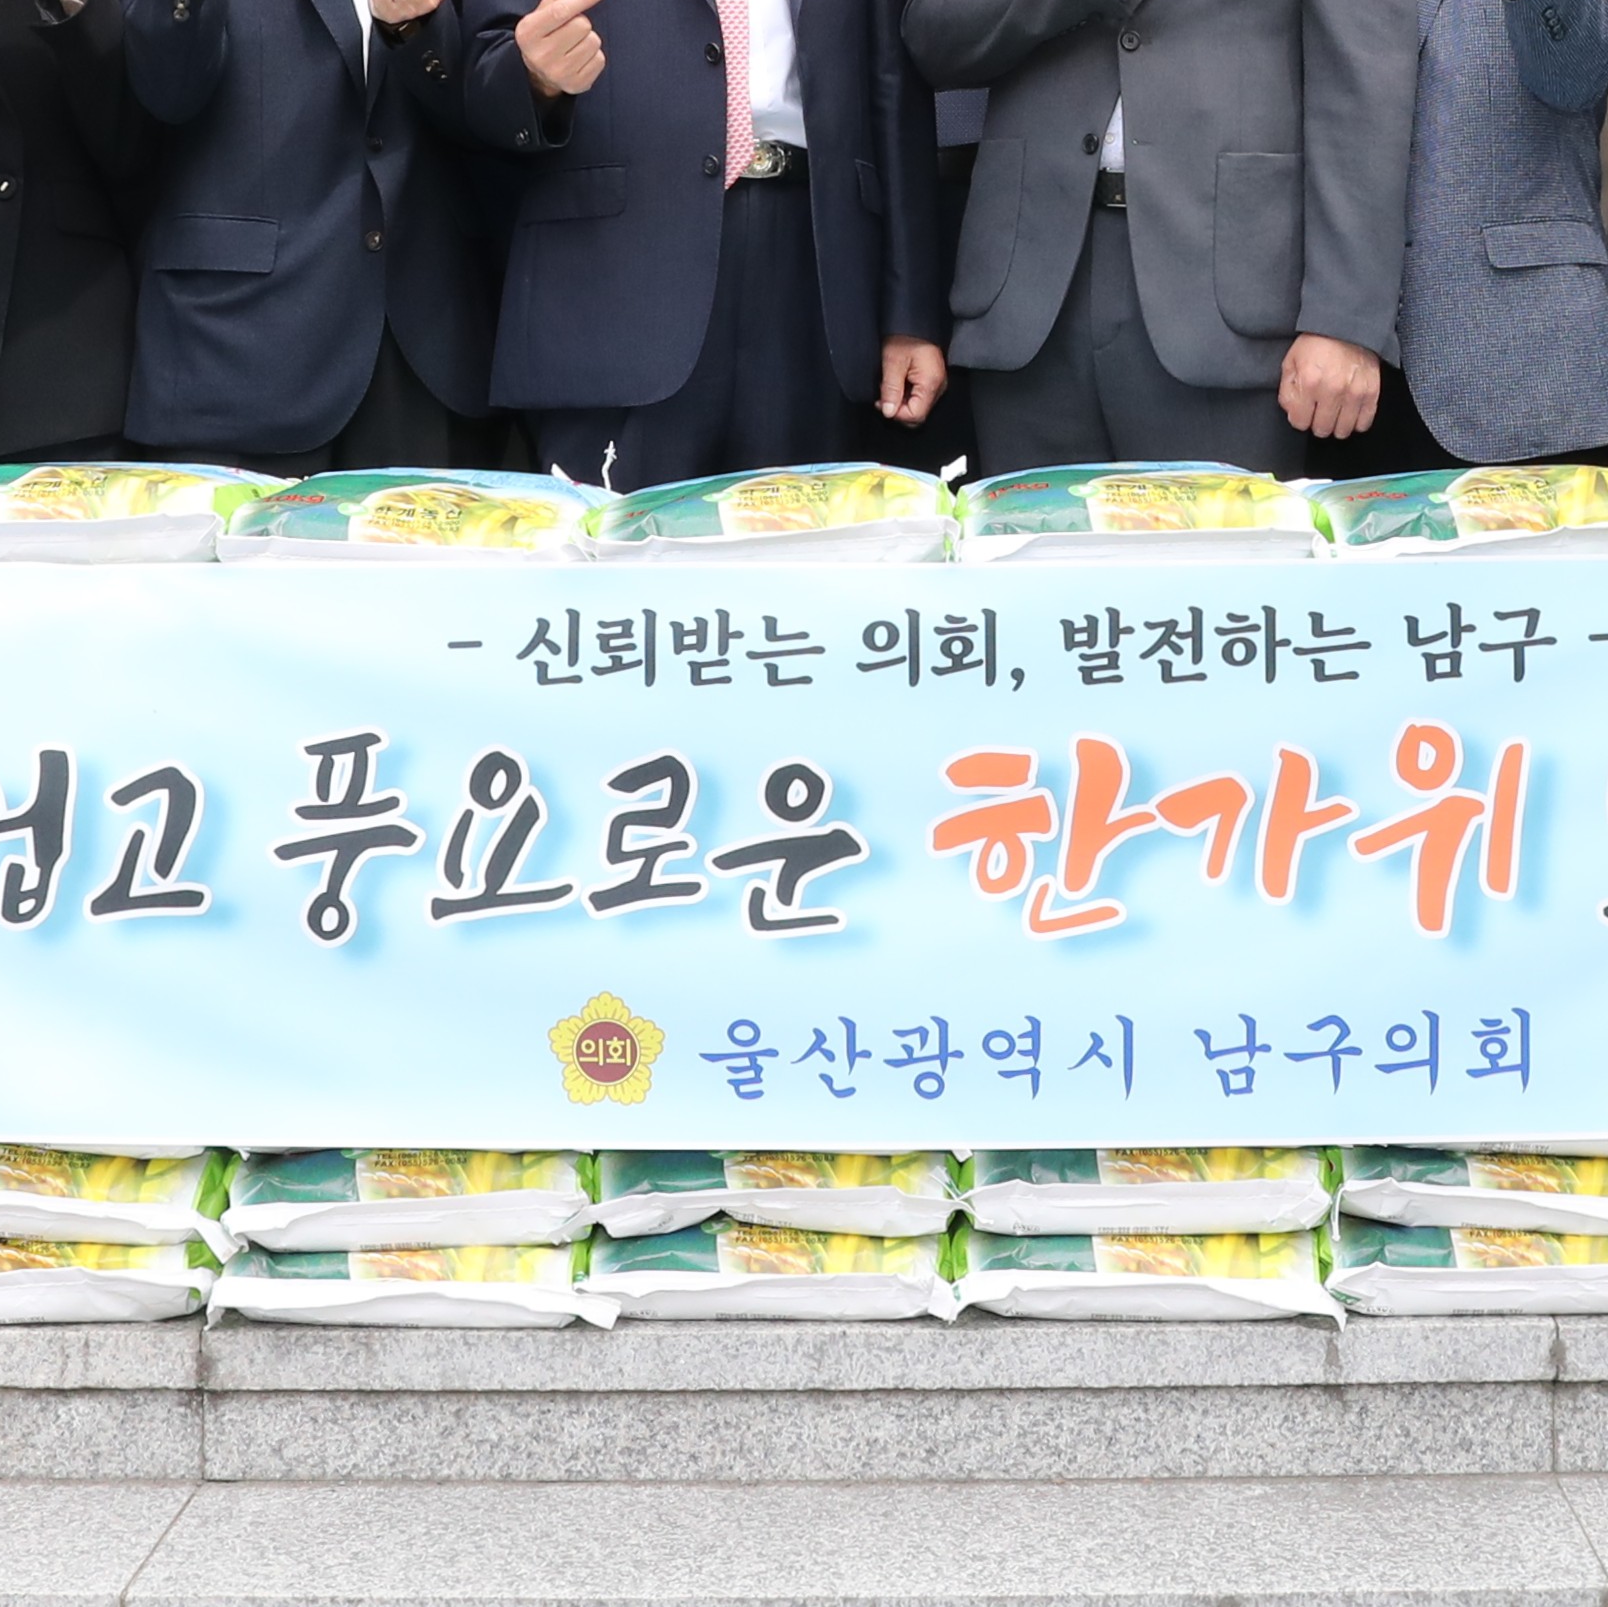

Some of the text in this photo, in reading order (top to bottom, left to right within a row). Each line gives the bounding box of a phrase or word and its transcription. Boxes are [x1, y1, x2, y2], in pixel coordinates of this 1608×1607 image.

[517, 607, 826, 687] 신뢰받는
[857, 608, 1027, 691] 의회,
[1061, 606, 1374, 684] 발전하는
[1403, 601, 1558, 684] 남구
[274, 731, 862, 942] 풍요로운
[932, 722, 1524, 933] 한가위
[578, 1036, 632, 1067] 의회
[698, 1007, 1535, 1100] 울산광역시 남구의회
